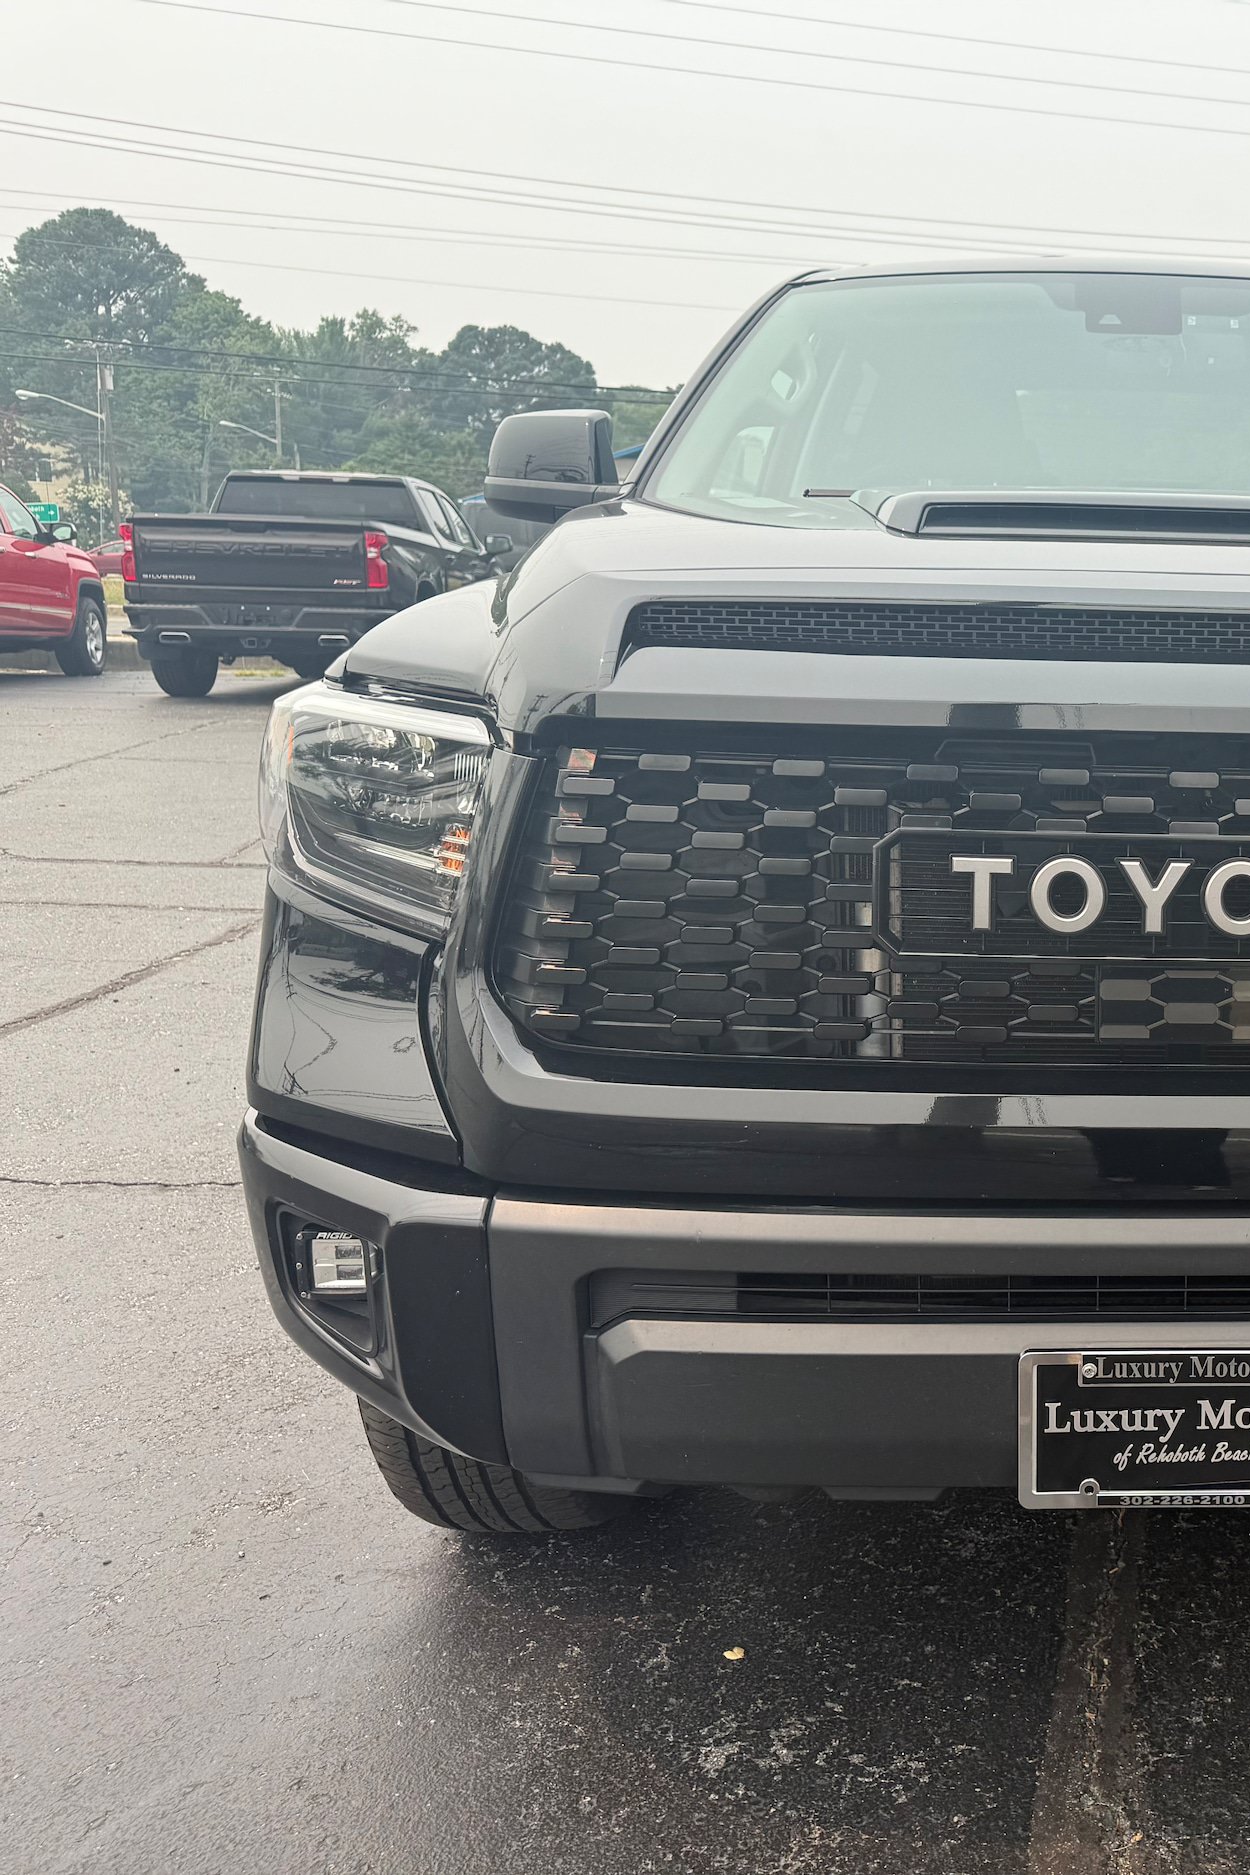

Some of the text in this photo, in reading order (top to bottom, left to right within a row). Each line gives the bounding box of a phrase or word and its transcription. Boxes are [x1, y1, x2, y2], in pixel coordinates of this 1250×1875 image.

[1095, 1357, 1184, 1383] Luxury
[1044, 1402, 1185, 1442] Luxury
[1113, 1444, 1134, 1471] of
[1136, 1443, 1206, 1465] Rehoboth
[1119, 1495, 1246, 1506] 302-226-2100
